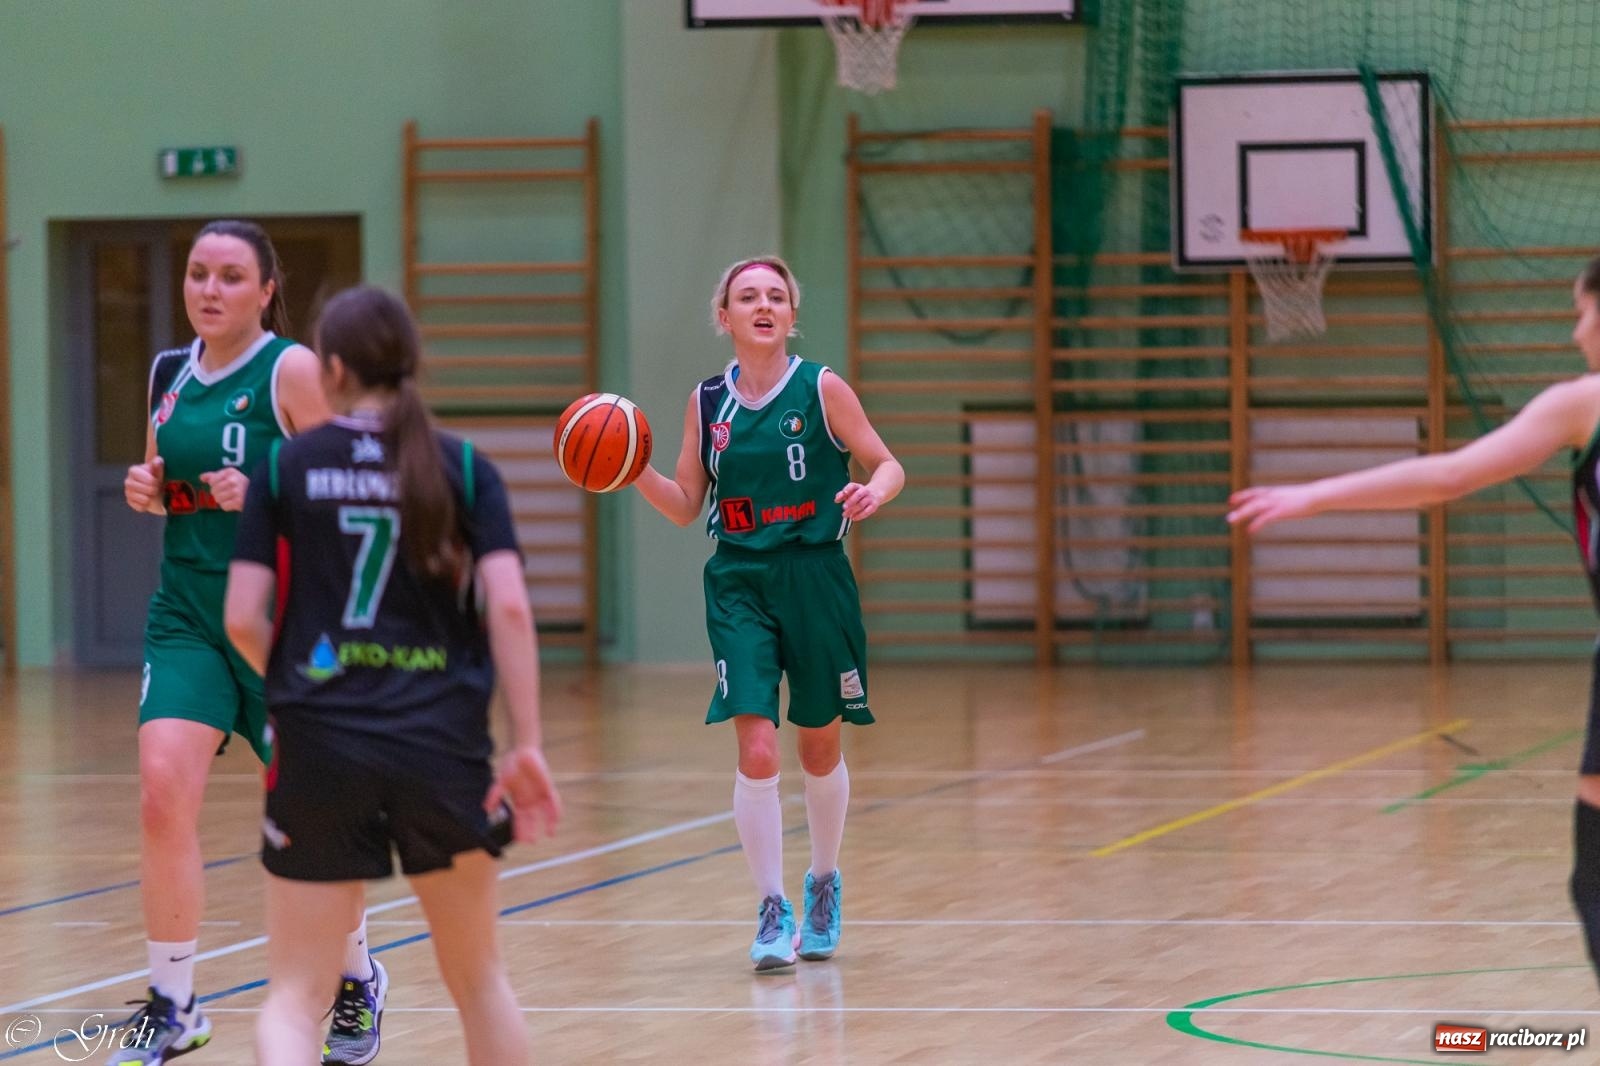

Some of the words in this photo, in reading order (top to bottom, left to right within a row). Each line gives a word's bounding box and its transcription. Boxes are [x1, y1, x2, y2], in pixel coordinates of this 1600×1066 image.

[222, 422, 246, 466] 9
[786, 443, 806, 482] 8
[724, 501, 751, 529] K
[338, 506, 400, 630] 7
